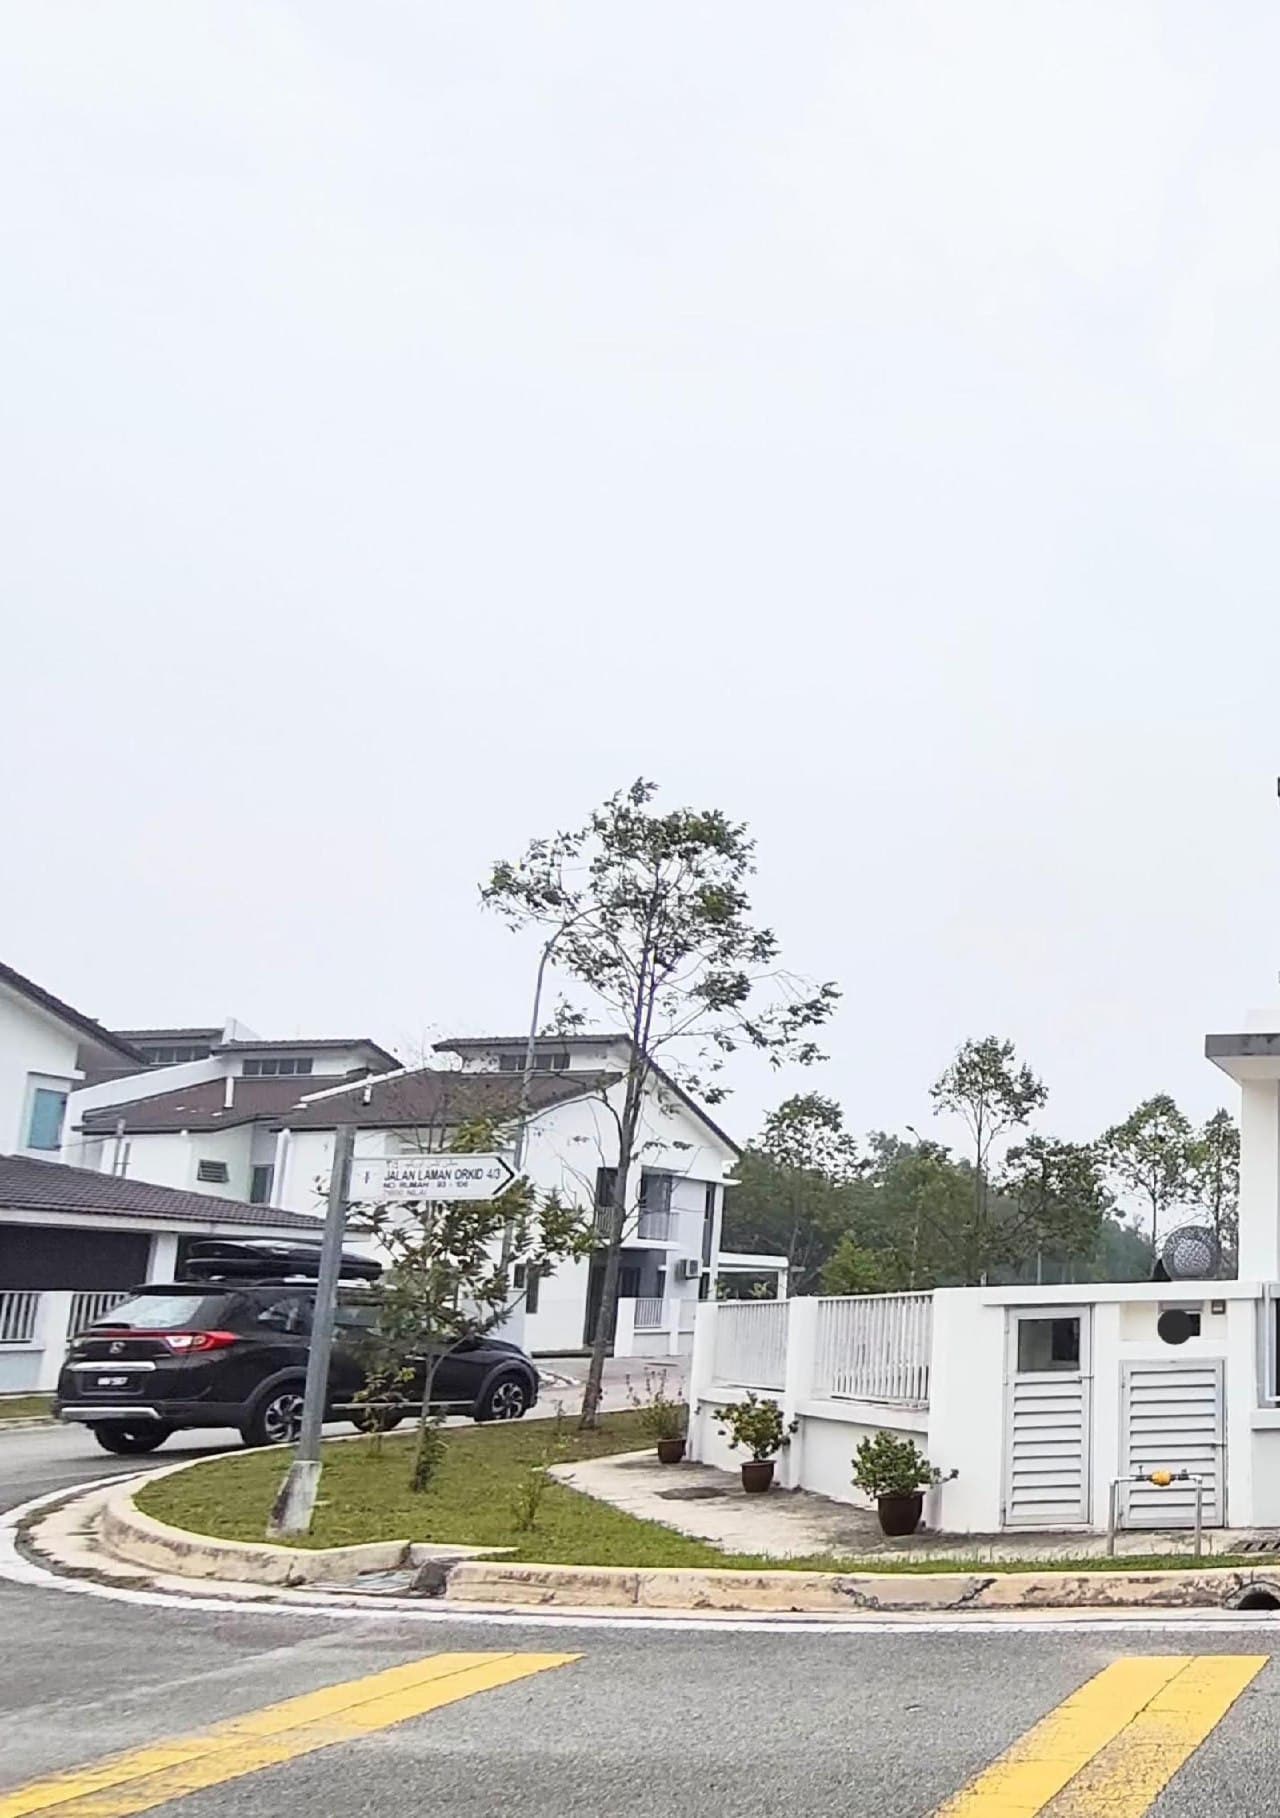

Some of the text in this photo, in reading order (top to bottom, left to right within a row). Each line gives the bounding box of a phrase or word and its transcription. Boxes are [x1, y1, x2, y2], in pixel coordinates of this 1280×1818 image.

[384, 1168, 501, 1181] JALAN LAMAN ORKID 4/3
